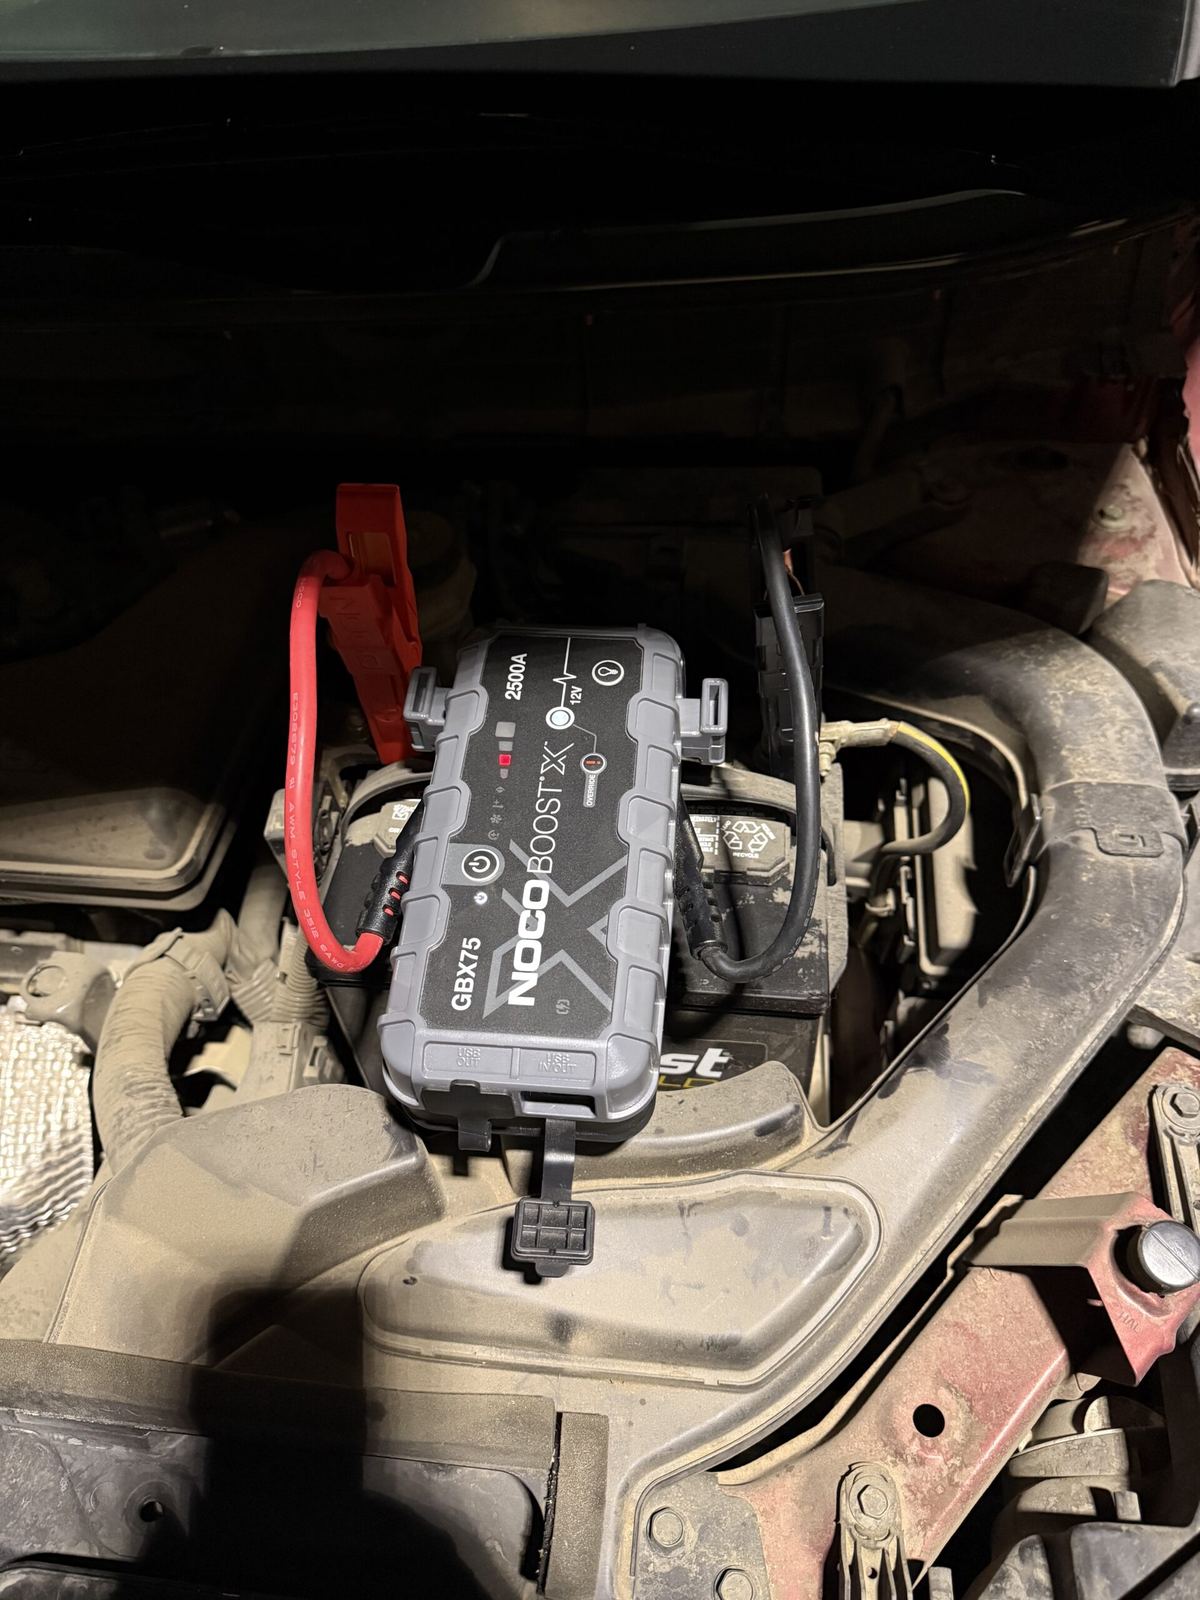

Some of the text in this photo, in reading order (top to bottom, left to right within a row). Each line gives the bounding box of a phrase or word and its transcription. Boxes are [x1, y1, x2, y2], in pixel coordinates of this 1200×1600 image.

[504, 653, 528, 701] 2500A
[569, 685, 583, 705] 12V
[586, 774, 596, 806] OVERRIDE
[288, 802, 296, 838] AWM
[527, 779, 563, 874] BOOST
[291, 849, 306, 901] STYLE
[507, 879, 551, 1007] NOCO
[451, 937, 482, 1011] GBX75
[456, 1057, 481, 1067] OUT
[457, 1047, 481, 1057] USB
[538, 1061, 577, 1073] IN/OUT
[546, 1052, 571, 1063] USB
